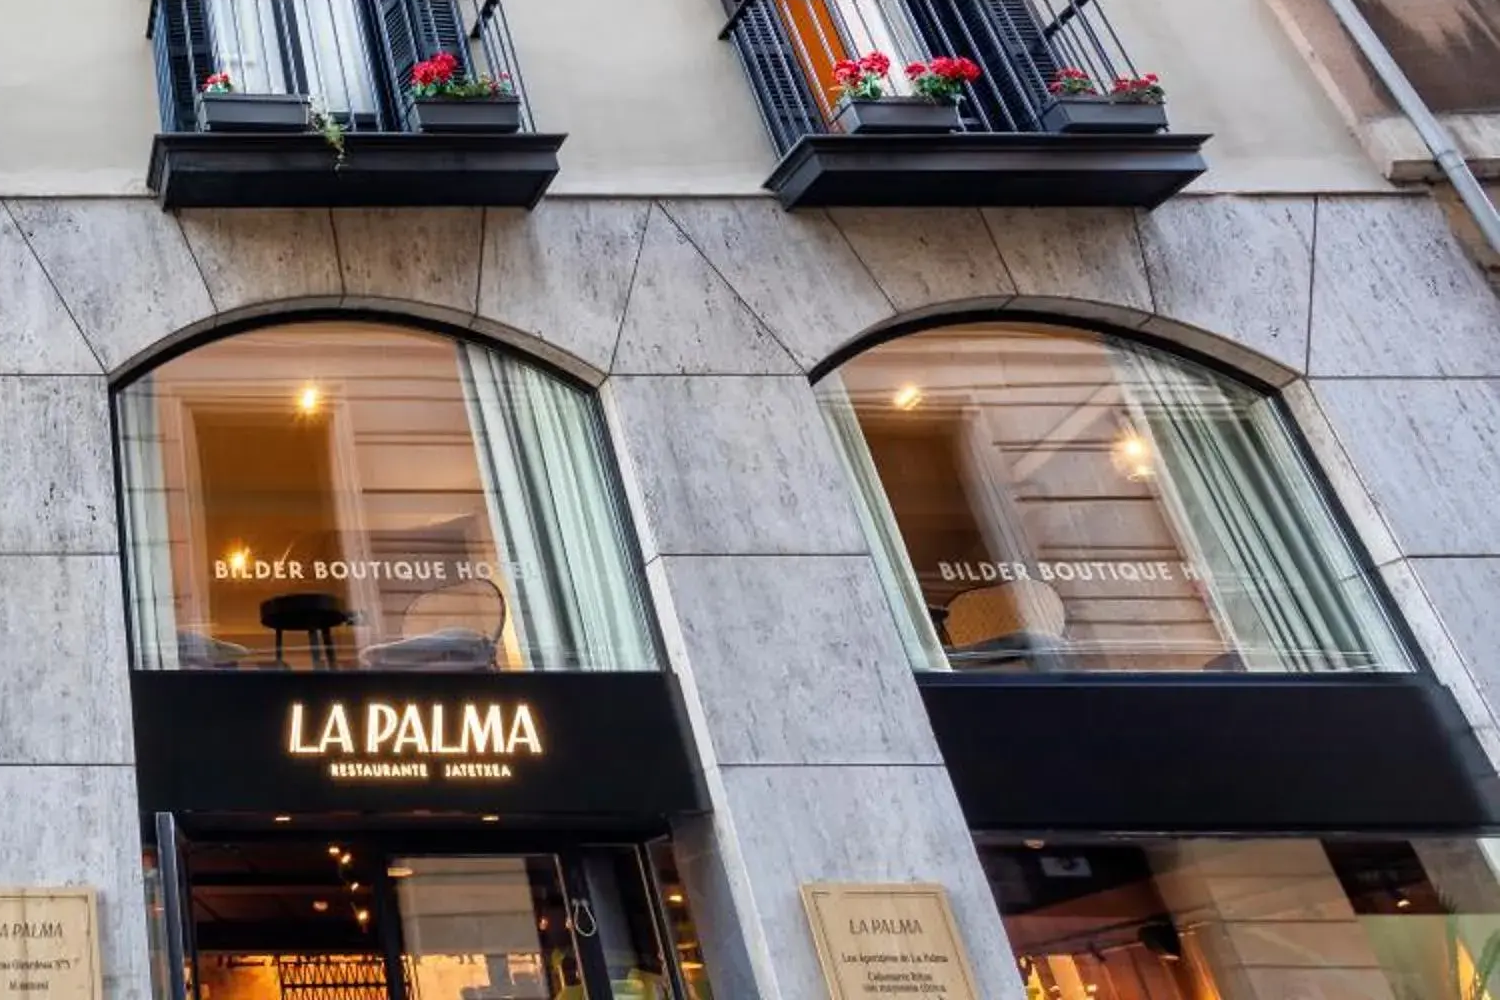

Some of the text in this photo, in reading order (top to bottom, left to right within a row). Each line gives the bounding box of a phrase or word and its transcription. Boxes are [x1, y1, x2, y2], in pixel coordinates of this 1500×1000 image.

[214, 560, 538, 581] BILDER BOUTIQUE HOE
[938, 561, 1031, 582] BILDER
[1038, 560, 1174, 582] BOUTIQUE
[288, 703, 543, 753] LA PALMA
[330, 763, 512, 778] RESTAURANTE JATETXEA
[12, 922, 64, 940] PALMA
[850, 919, 924, 935] LA PALMA
